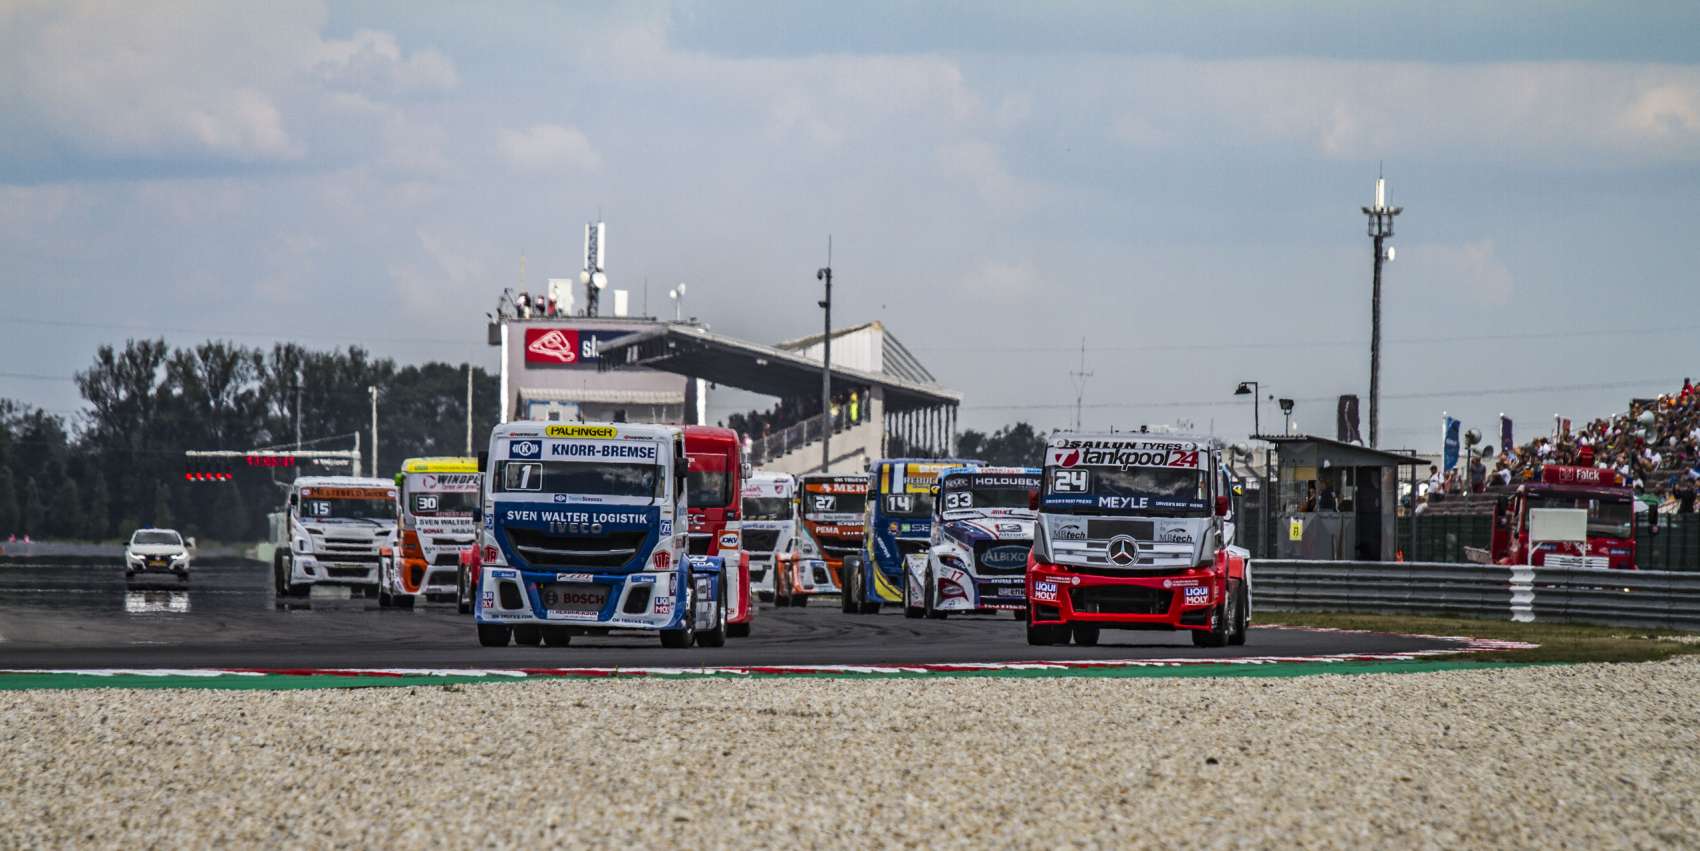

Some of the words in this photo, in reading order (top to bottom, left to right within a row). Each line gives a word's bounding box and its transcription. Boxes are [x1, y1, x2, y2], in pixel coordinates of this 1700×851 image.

[550, 426, 613, 437] PALFINGER
[521, 444, 529, 454] K
[551, 443, 655, 459] KNORR-BREMSE
[1070, 440, 1137, 449] SAILUN
[1142, 442, 1183, 450] TYRES
[1082, 448, 1199, 471] tankpool24
[520, 464, 532, 489] 1
[1576, 469, 1600, 480] Falck
[1055, 471, 1087, 491] 24
[419, 497, 437, 509] 30
[815, 495, 834, 509] 27
[889, 496, 910, 511] 14
[947, 493, 972, 508] 33
[1098, 496, 1149, 509] MEYLE
[312, 502, 329, 514] 15
[507, 510, 537, 521] SVEN
[541, 511, 589, 522] WALTER
[593, 513, 648, 524] LOGISTIK
[549, 521, 602, 534] IVECO
[815, 526, 839, 534] PEMA
[721, 536, 738, 544] DKV
[1035, 581, 1056, 591] LIQUI
[1185, 587, 1208, 596] LIQUI
[563, 593, 604, 605] BOSCH
[1035, 591, 1056, 600] MOLY
[1186, 595, 1208, 604] MOLY
